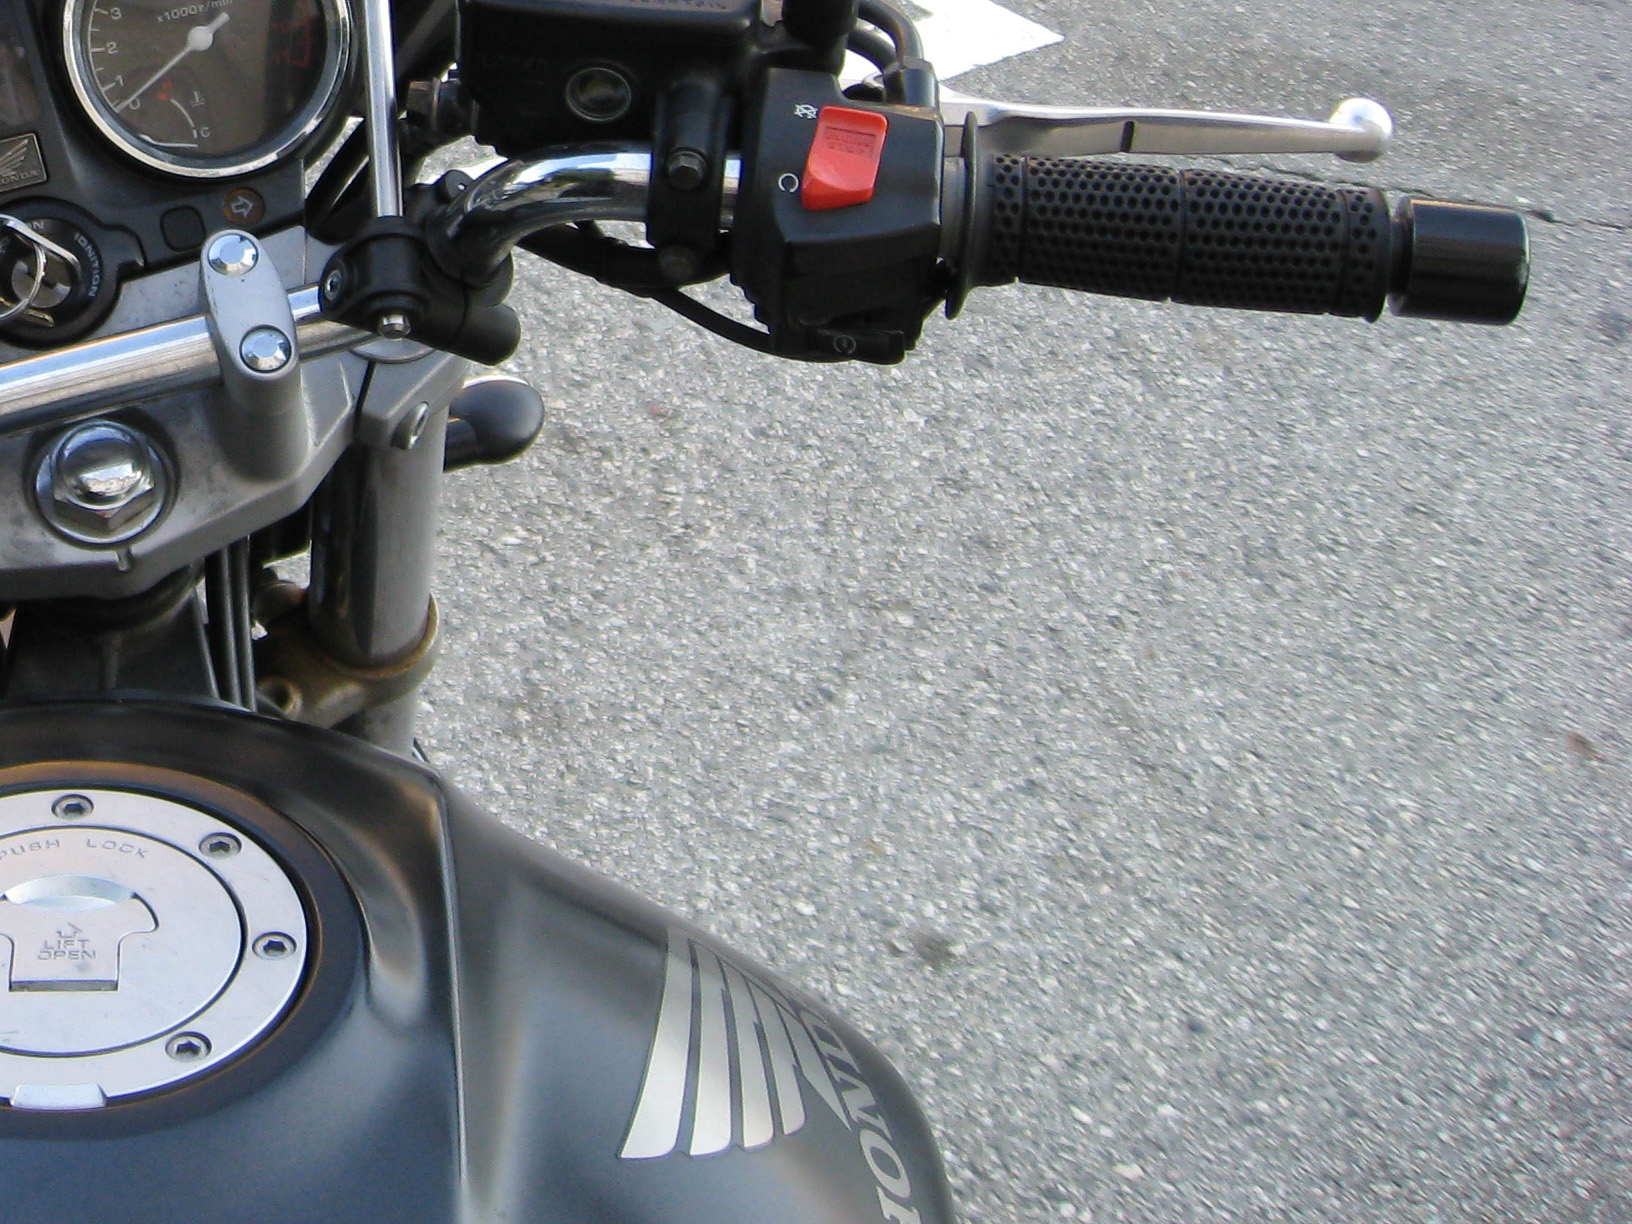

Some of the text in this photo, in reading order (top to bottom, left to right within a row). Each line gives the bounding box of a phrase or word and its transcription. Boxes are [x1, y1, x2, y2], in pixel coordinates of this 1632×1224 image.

[110, 7, 123, 21] 3
[106, 41, 118, 55] 2
[115, 75, 125, 87] 1
[74, 232, 101, 297] IGNITION
[85, 838, 149, 859] LOCK
[43, 939, 90, 950] LIFT
[36, 950, 97, 961] OPEN
